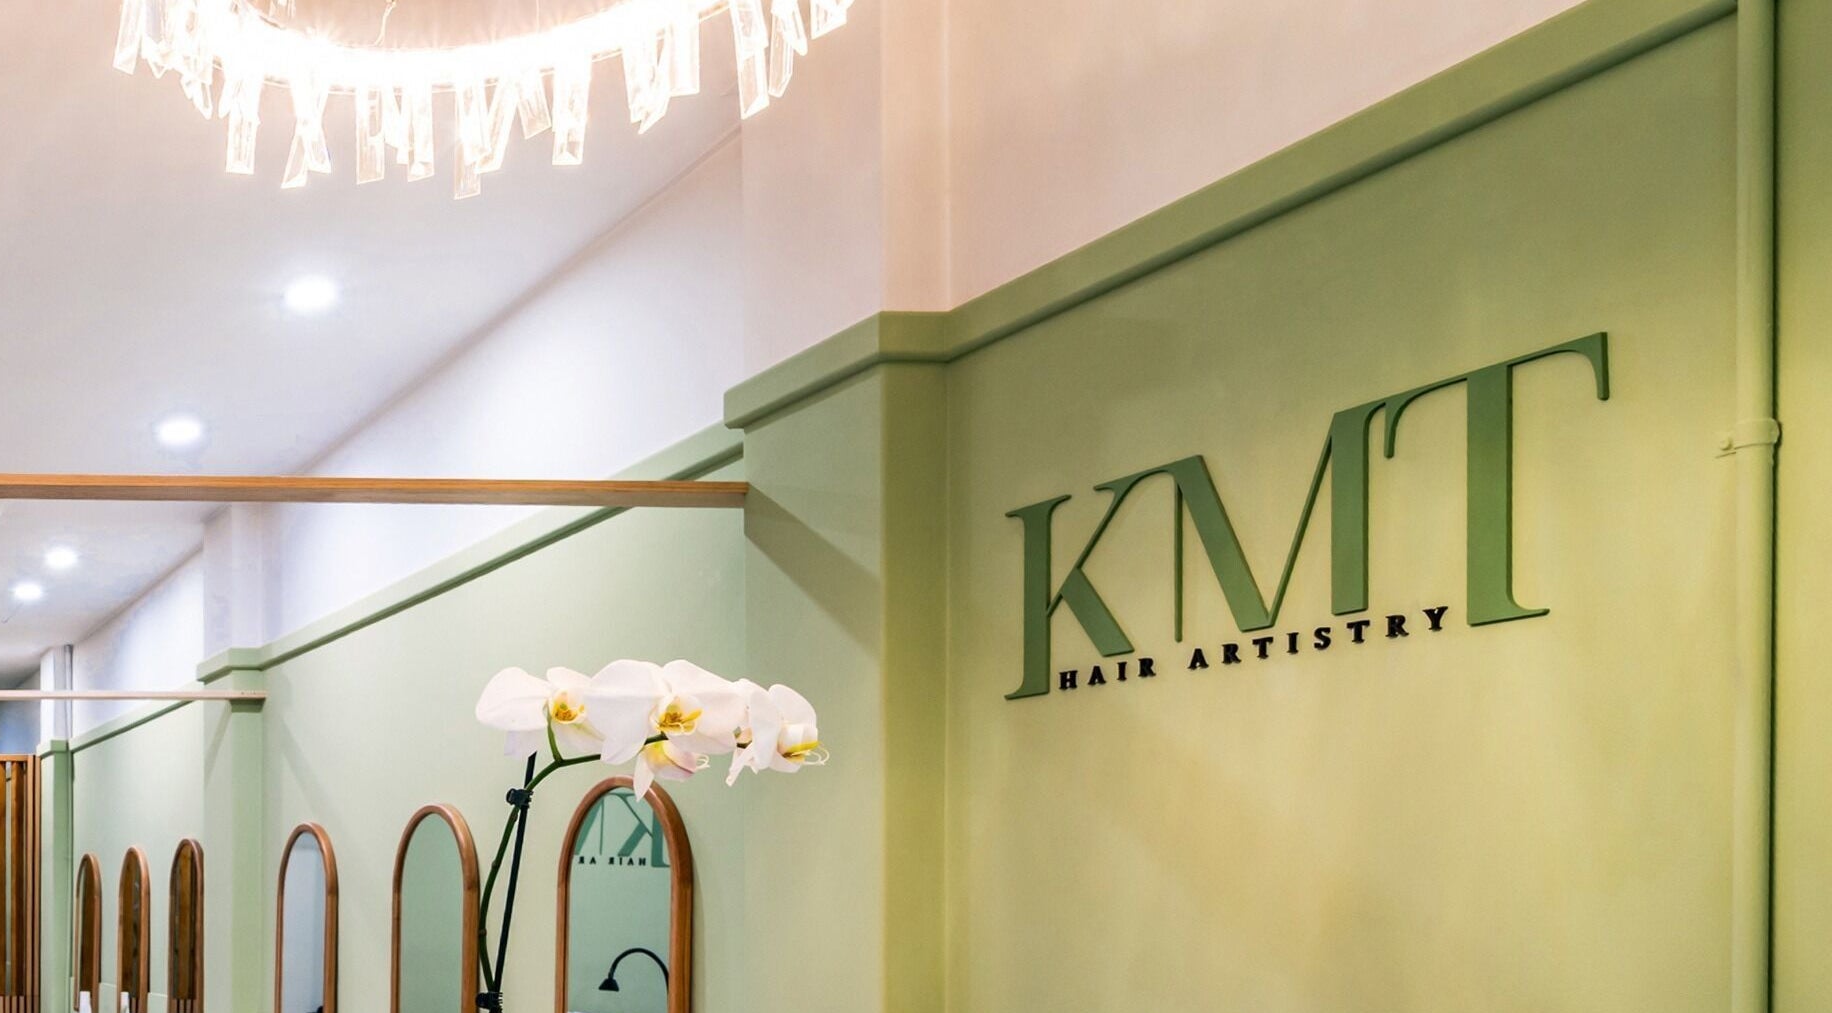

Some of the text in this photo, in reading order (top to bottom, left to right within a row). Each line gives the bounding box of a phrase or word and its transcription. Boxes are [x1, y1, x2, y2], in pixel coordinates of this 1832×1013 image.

[1004, 331, 1609, 700] KMT
[1058, 605, 1449, 691] HAIR ARTISTRY
